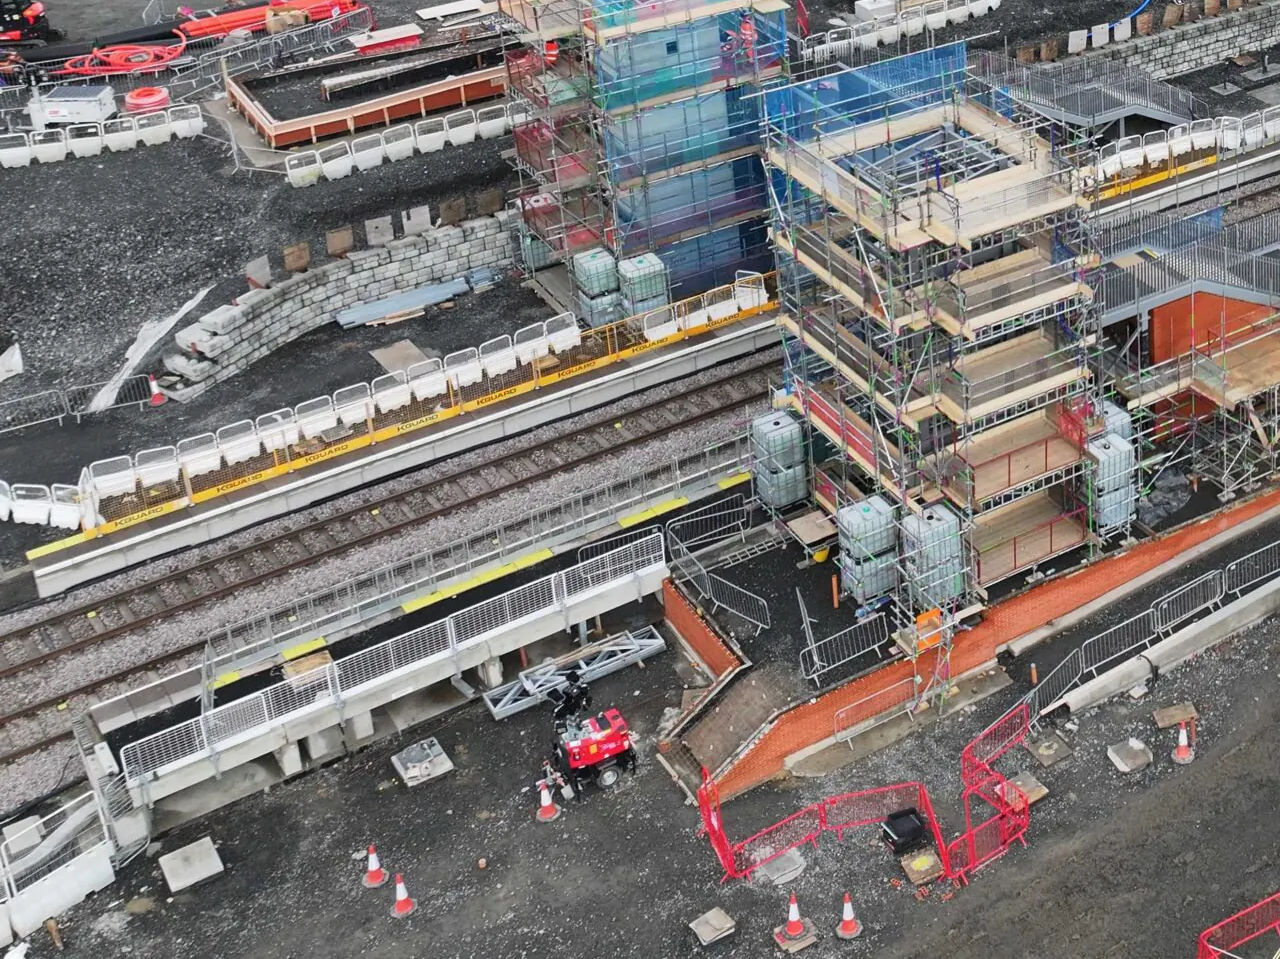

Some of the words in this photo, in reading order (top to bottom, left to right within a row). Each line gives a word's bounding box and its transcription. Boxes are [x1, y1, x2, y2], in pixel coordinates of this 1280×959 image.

[705, 313, 740, 328] KGUARD
[631, 337, 669, 353] KGUARD
[557, 361, 596, 378] KGUARD
[476, 387, 517, 406] KGUARD
[397, 414, 439, 432] KGUARD
[305, 444, 349, 463] KGUARD
[216, 473, 263, 493] KGUARD
[114, 506, 163, 527] KGUARD
